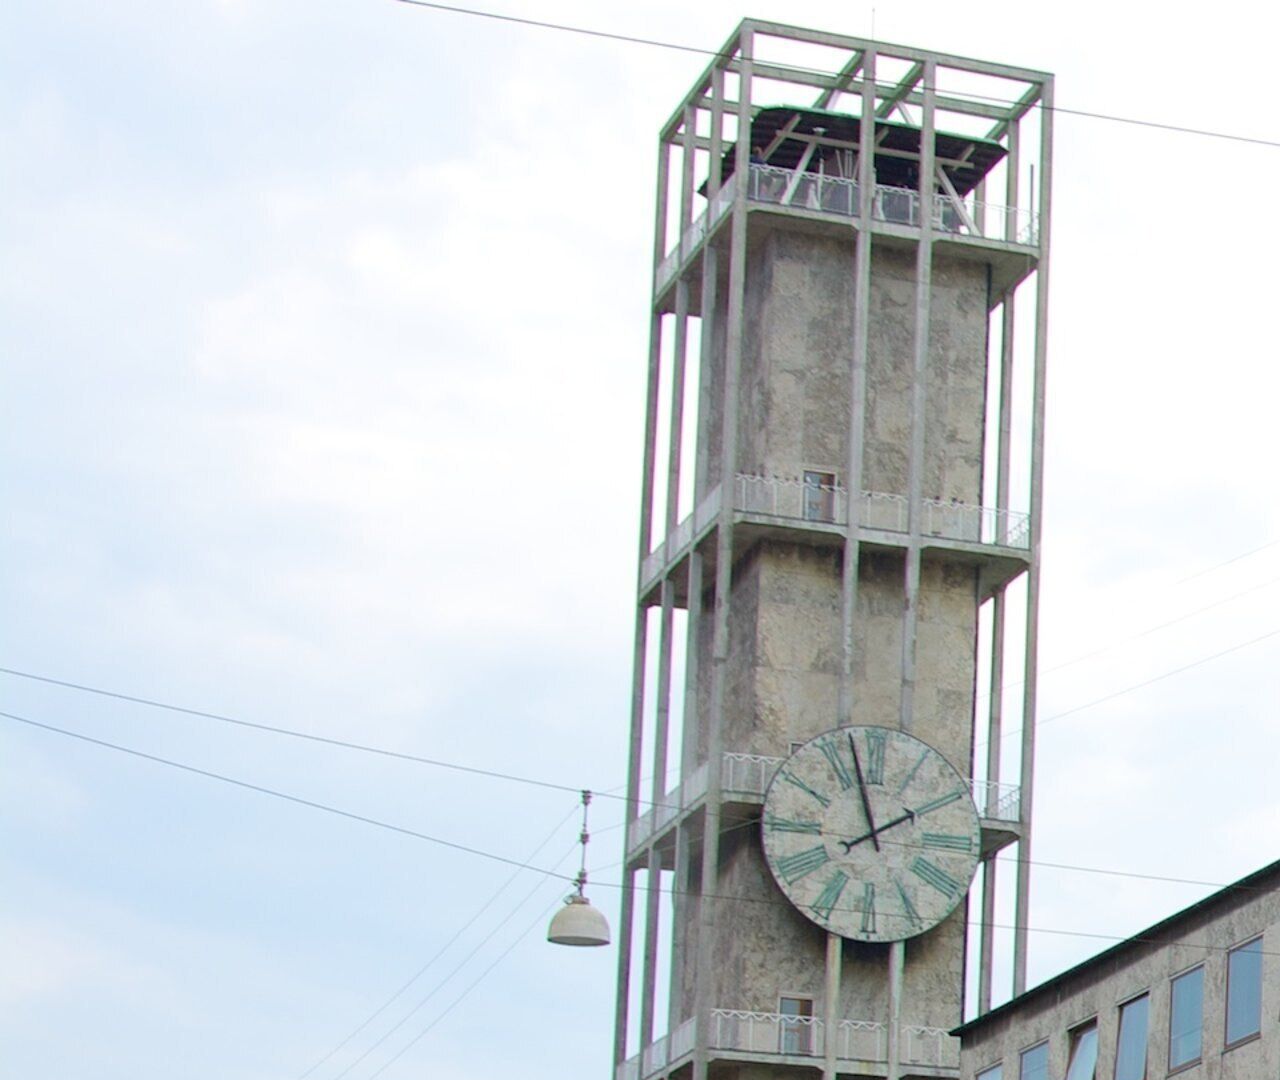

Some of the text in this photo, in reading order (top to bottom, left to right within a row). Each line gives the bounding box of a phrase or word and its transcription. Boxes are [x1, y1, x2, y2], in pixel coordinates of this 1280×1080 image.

[812, 737, 852, 791] XI
[864, 729, 887, 785] XII
[898, 749, 930, 794] I
[780, 769, 831, 808] X
[914, 787, 962, 817] II
[767, 811, 822, 836] IX
[922, 832, 972, 852] III
[776, 844, 831, 887] VIII
[809, 870, 850, 920] VII
[861, 883, 877, 933] VI
[893, 876, 923, 927] V
